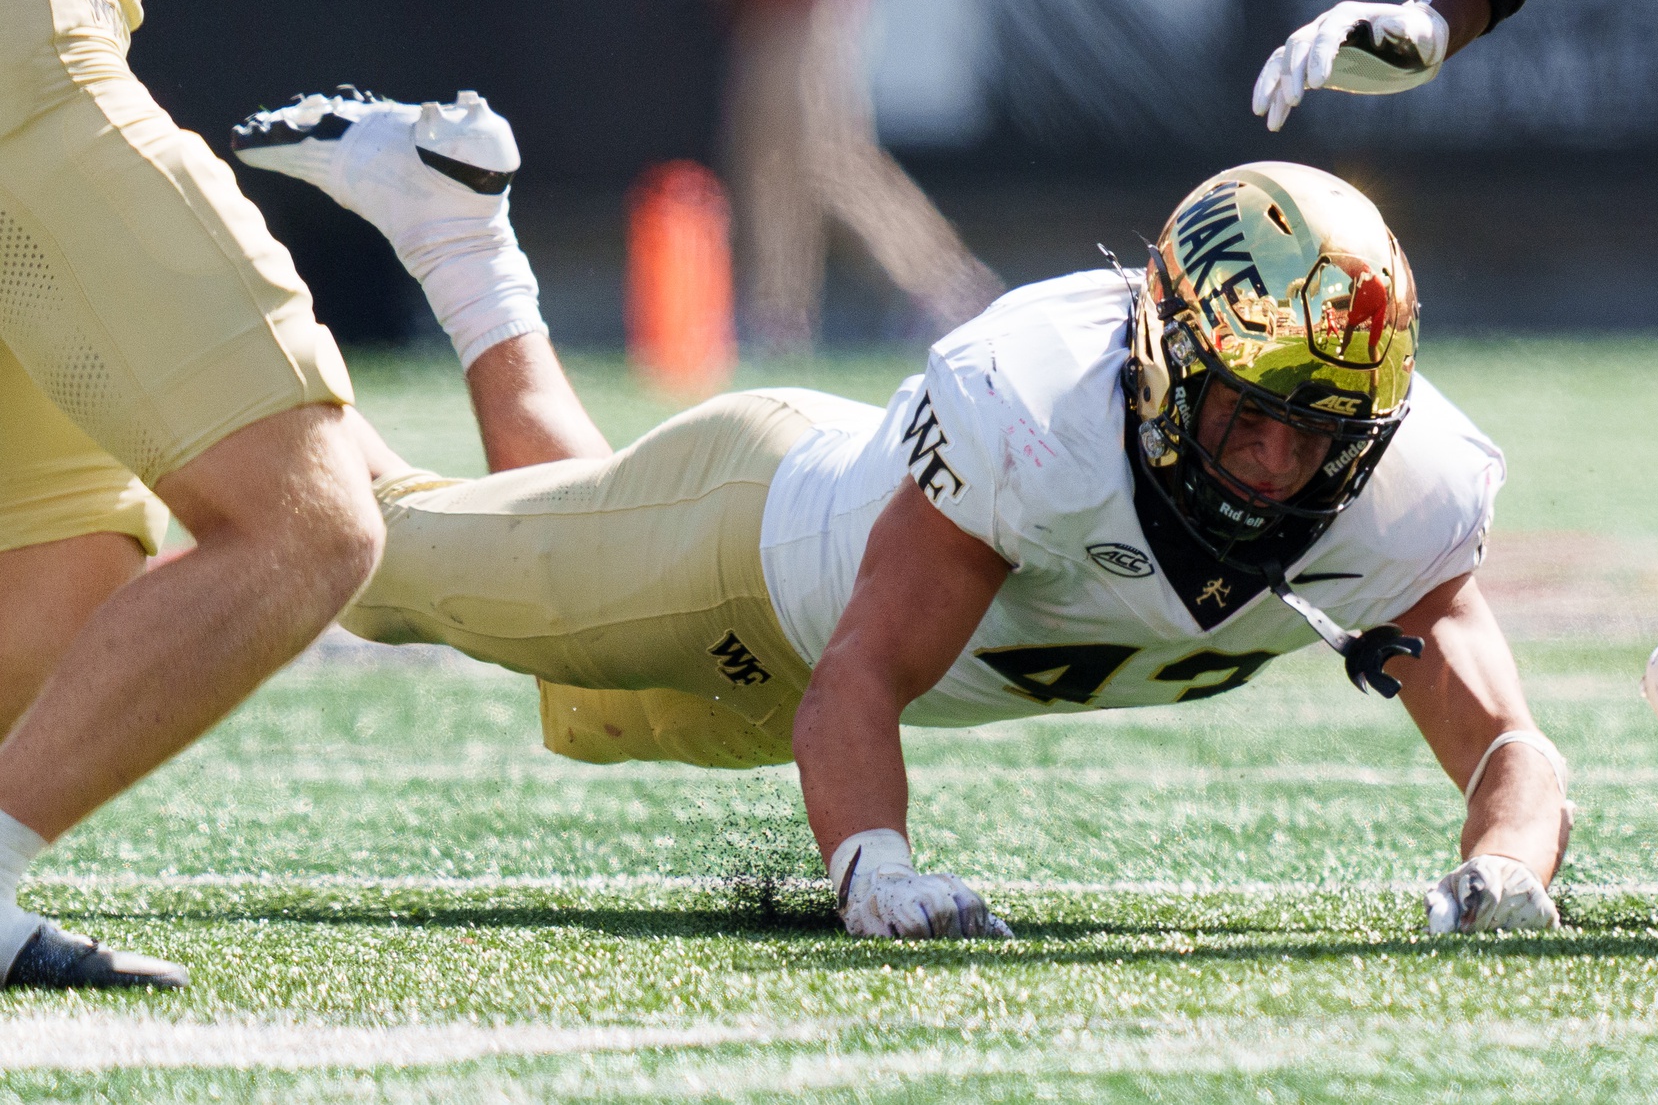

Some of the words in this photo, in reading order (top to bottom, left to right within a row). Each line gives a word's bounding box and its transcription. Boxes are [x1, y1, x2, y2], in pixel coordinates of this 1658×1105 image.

[1176, 181, 1269, 330] WAKE
[1175, 385, 1192, 429] Ridd
[1312, 395, 1363, 415] ACC
[901, 388, 967, 501] WF
[1322, 439, 1368, 478] Ridde
[1098, 549, 1148, 573] ACC
[708, 631, 772, 686] WF
